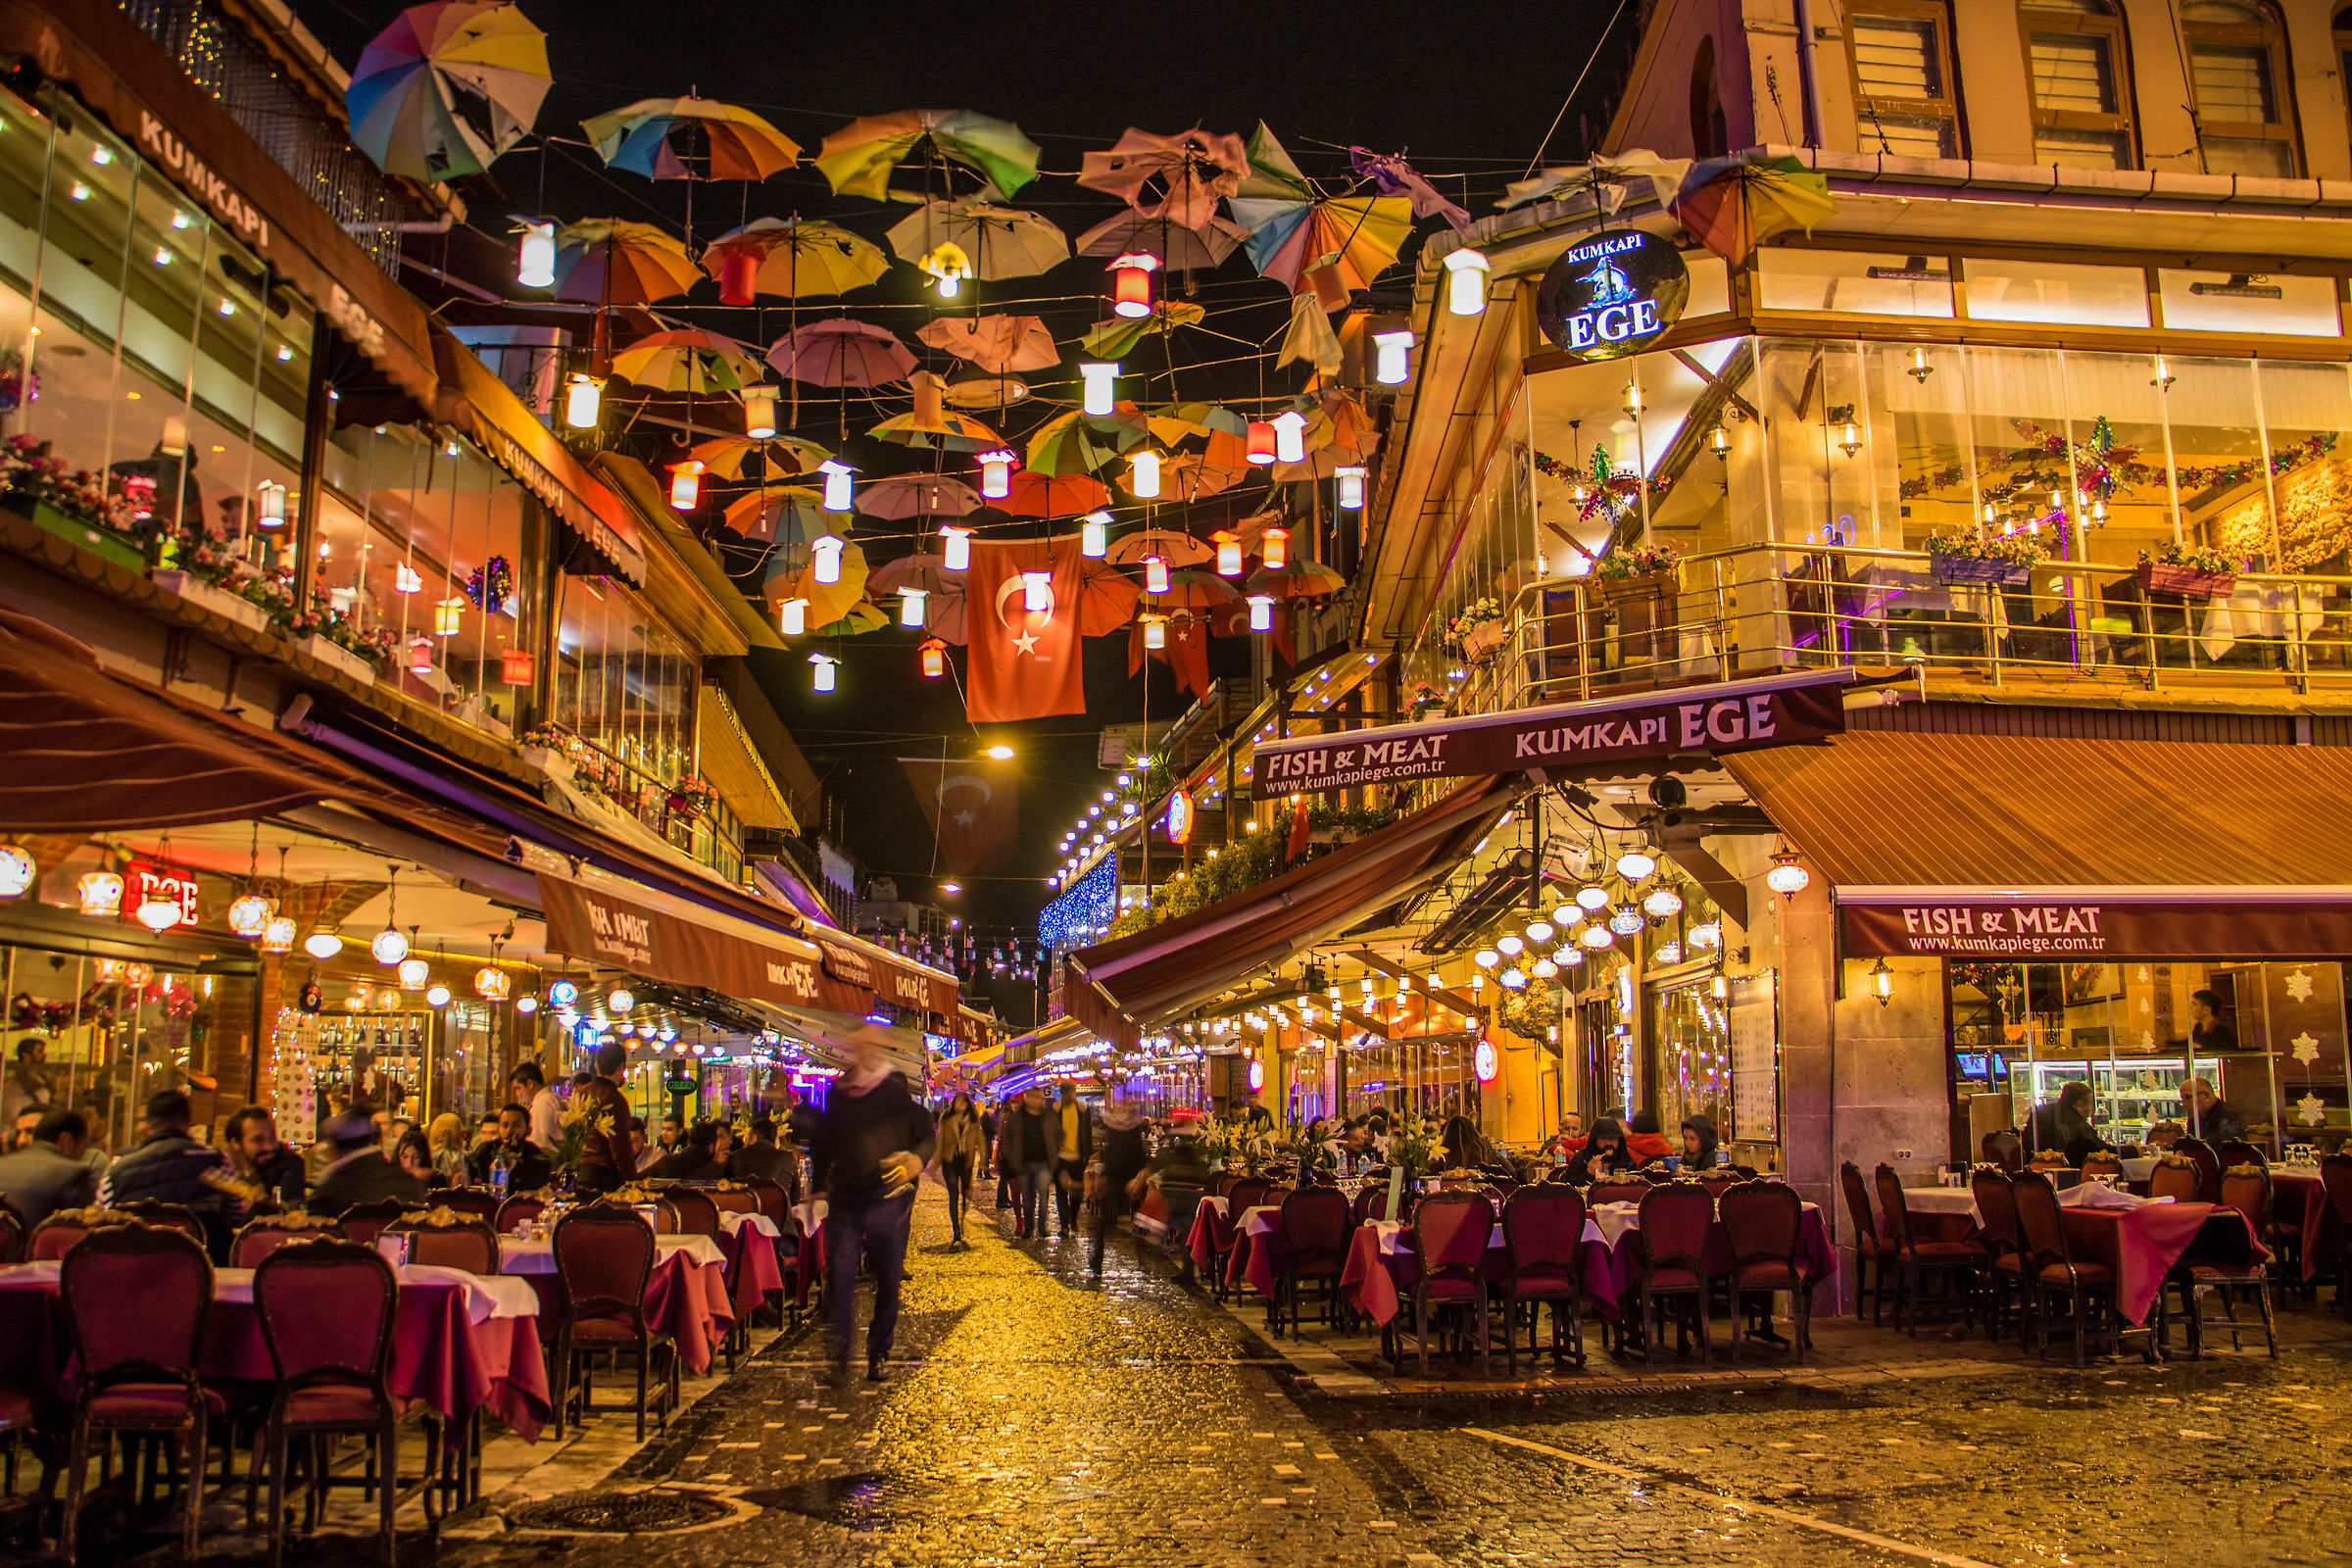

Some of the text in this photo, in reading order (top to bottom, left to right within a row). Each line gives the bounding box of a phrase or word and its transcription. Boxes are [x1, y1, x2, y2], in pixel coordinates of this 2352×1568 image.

[141, 109, 269, 247] KUMKAPI
[1567, 233, 1642, 265] KUMKAPI
[1566, 298, 1660, 350] EGE
[1515, 693, 1777, 759] KUMKAPI EGE
[1267, 734, 1448, 779] FISH & MEAT
[1265, 759, 1446, 795] www.kumkapiege.com.tr
[1902, 906, 2101, 935] FISH & MEAT
[1908, 934, 2106, 953] www.kumkapiege.com.tr
[667, 1079, 697, 1090] GREEN
